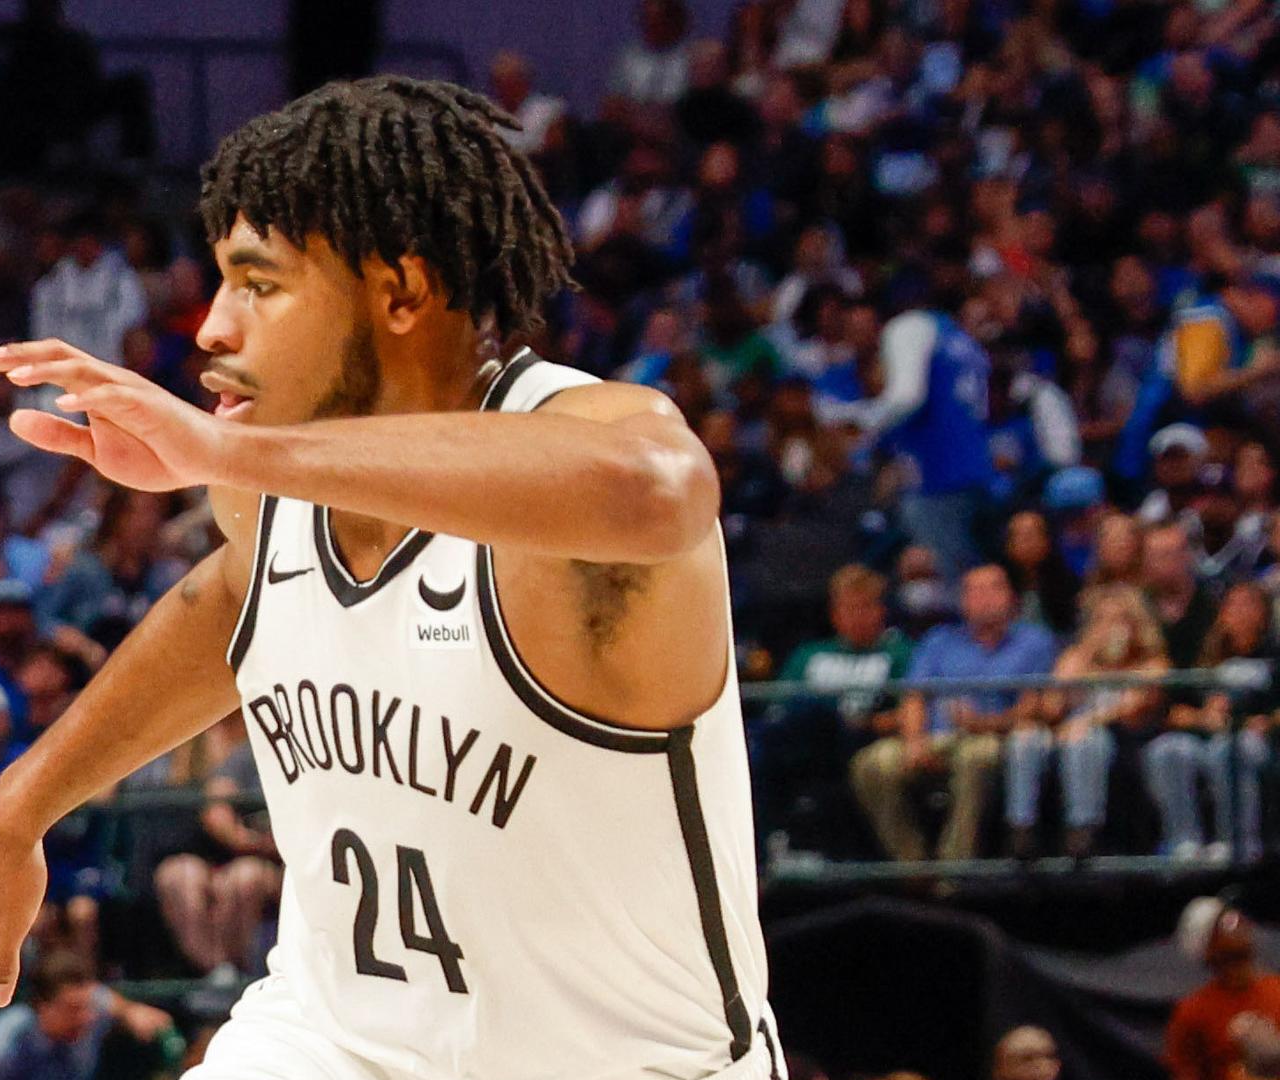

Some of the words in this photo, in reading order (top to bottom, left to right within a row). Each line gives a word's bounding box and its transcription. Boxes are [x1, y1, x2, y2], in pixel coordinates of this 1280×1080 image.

[416, 624, 470, 642] Webull
[248, 679, 538, 830] BROOKLYN
[331, 827, 470, 995] 24
